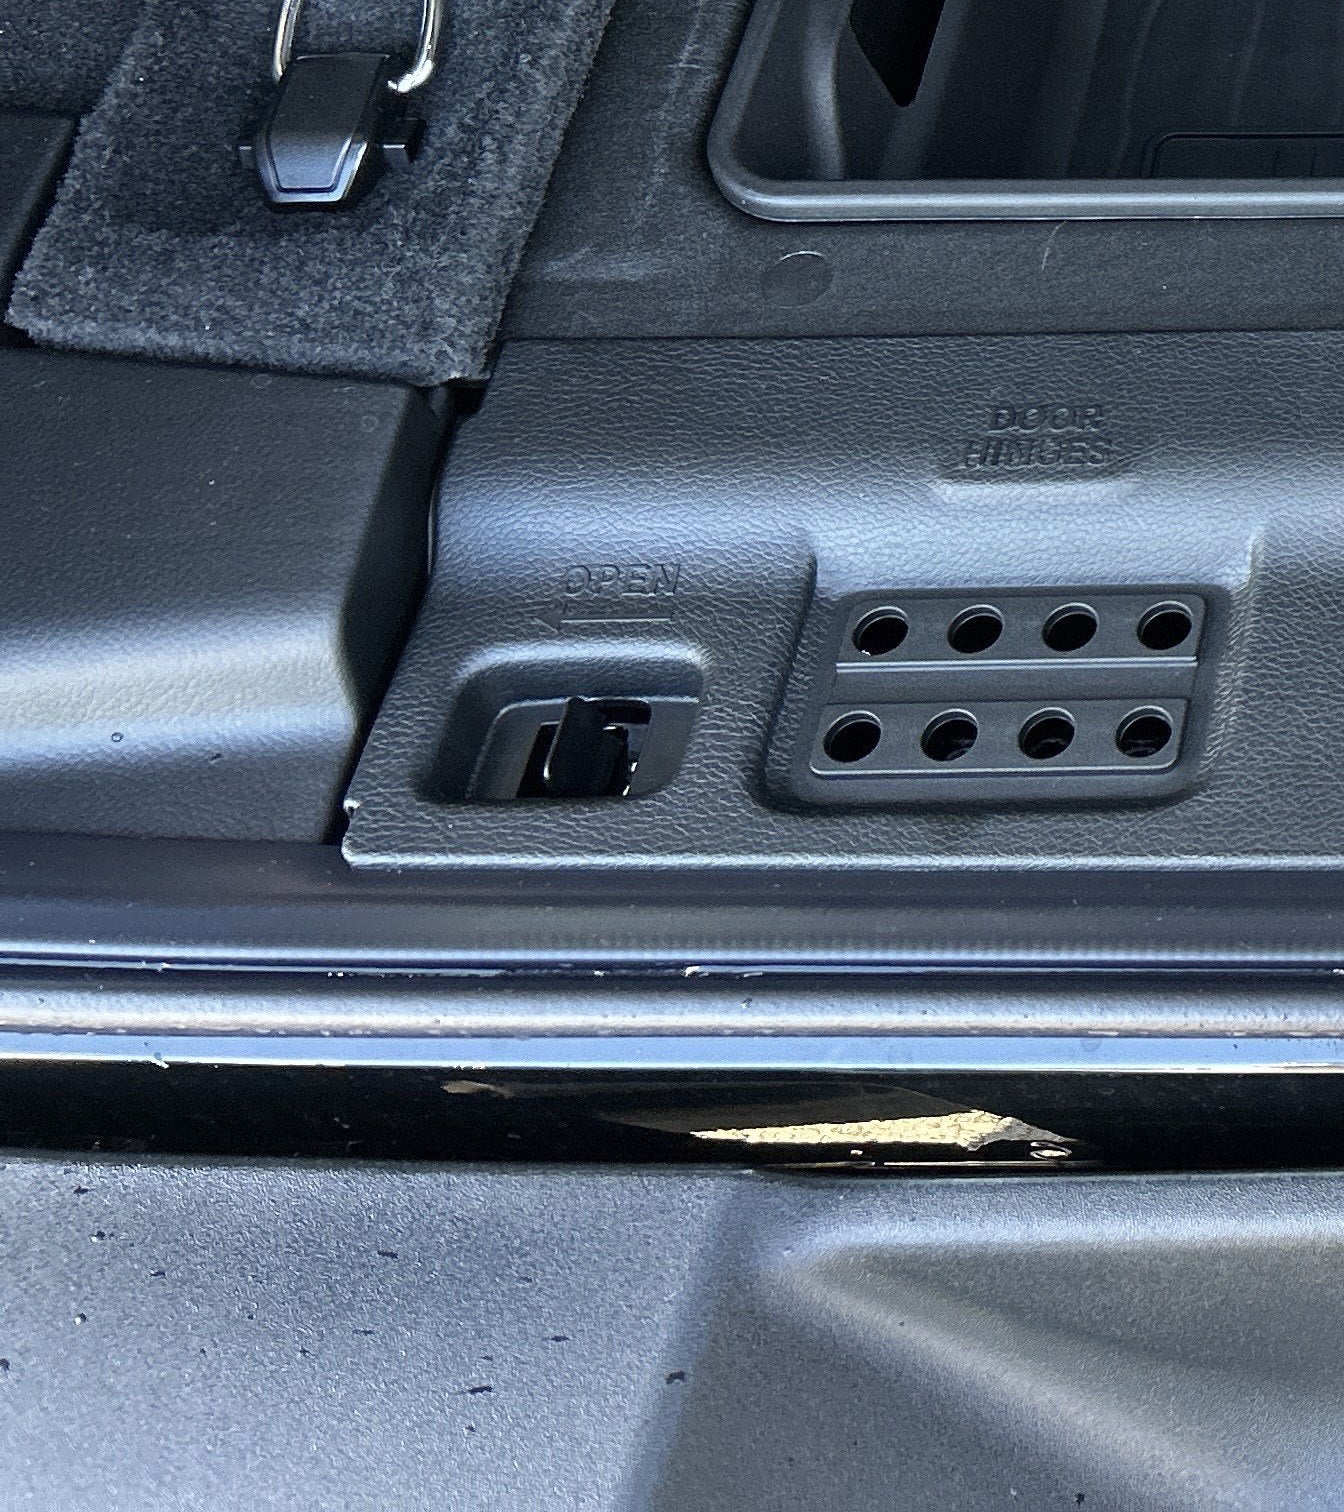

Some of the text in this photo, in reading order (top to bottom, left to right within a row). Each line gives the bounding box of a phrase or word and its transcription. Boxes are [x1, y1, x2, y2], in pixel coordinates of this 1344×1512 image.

[988, 403, 1103, 433] DOOR
[963, 437, 1113, 469] HINGES
[563, 562, 682, 595] OPEN
